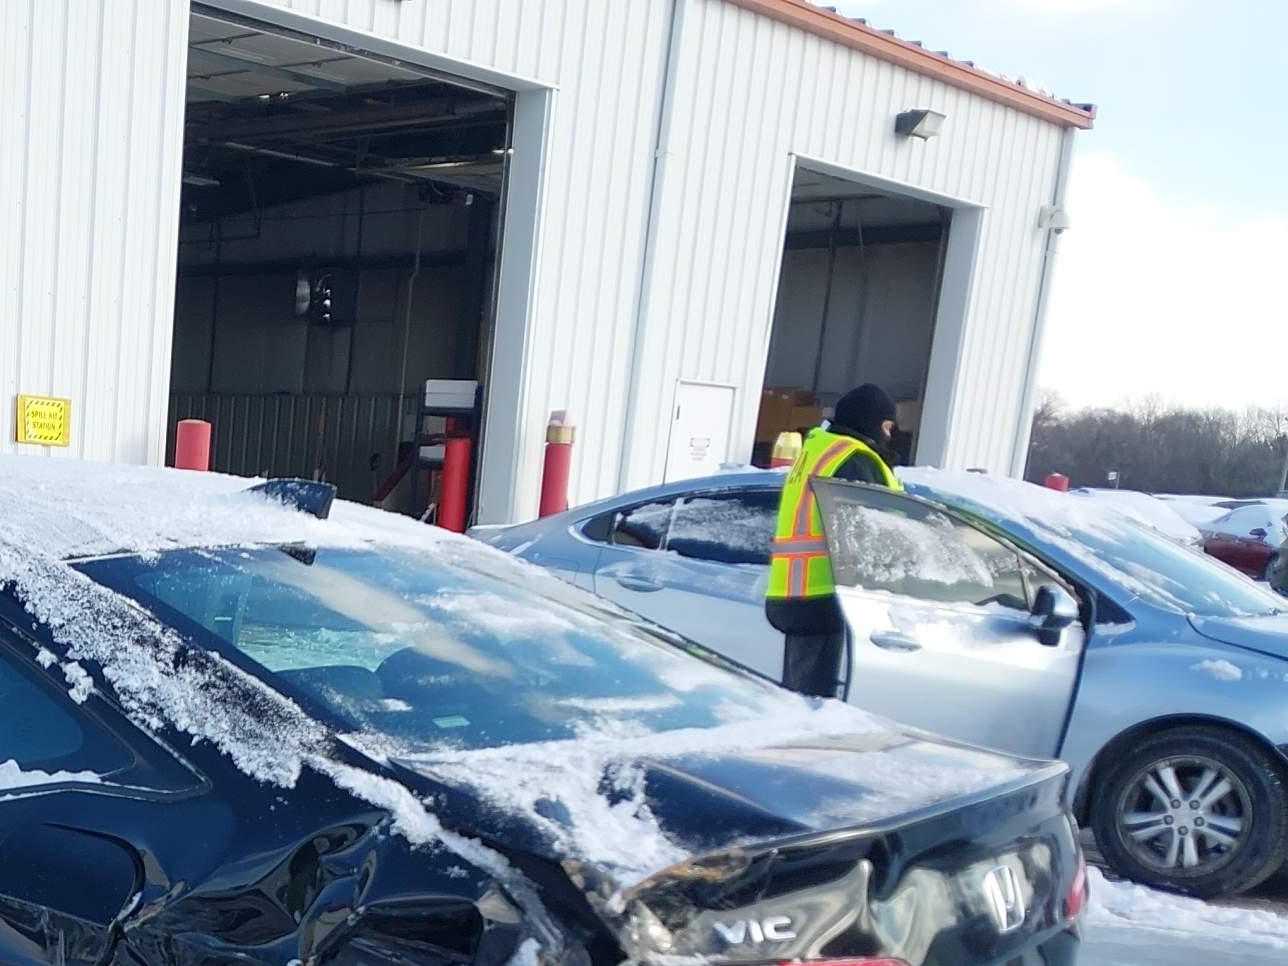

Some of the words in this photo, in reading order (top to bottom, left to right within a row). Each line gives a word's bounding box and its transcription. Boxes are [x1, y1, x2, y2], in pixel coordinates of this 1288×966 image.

[31, 411, 47, 419] SPILL
[48, 412, 58, 420] KIT
[32, 421, 56, 430] STATION
